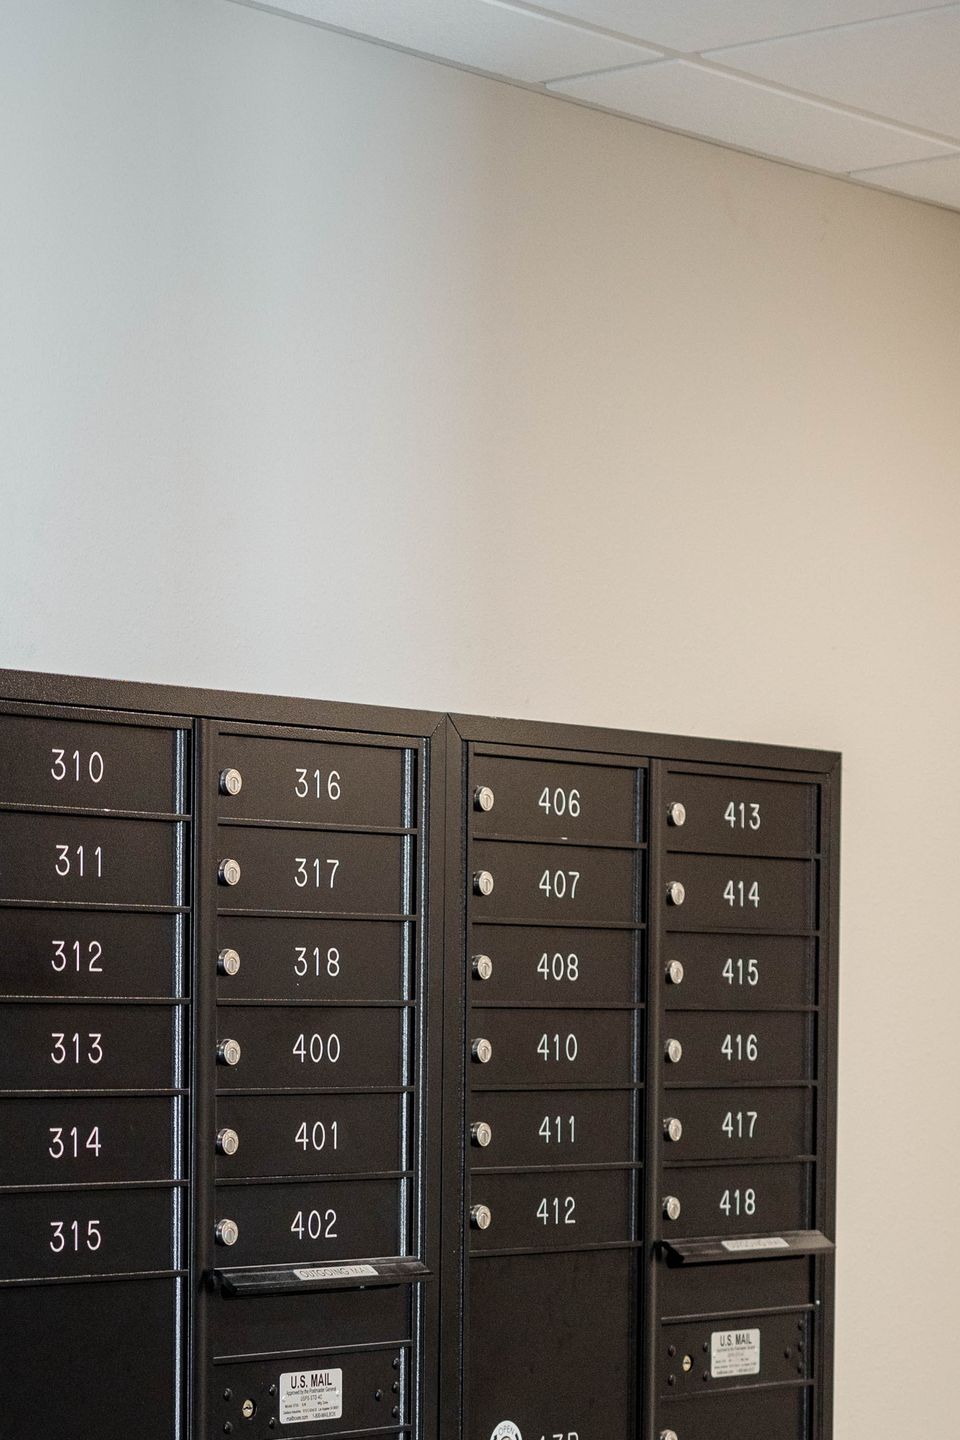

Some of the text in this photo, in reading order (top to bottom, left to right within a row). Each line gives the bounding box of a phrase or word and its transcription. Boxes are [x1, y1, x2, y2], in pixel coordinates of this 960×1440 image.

[50, 748, 104, 784] 310
[294, 767, 341, 801] 316
[537, 786, 581, 818] 406
[723, 801, 761, 831] 413
[54, 844, 102, 878] 311
[293, 857, 340, 889] 317
[538, 869, 580, 900] 407
[722, 879, 761, 909] 414
[51, 940, 103, 973] 312
[293, 946, 341, 977] 318
[536, 952, 579, 982] 408
[721, 957, 759, 986] 415
[50, 1032, 103, 1065] 313
[292, 1033, 341, 1064] 400
[536, 1033, 578, 1062] 410
[720, 1033, 758, 1062] 416
[294, 1120, 338, 1151] 401
[538, 1115, 575, 1144] 411
[721, 1110, 758, 1139] 417
[48, 1126, 102, 1159] 314
[536, 1196, 576, 1226] 412
[719, 1188, 756, 1217] 418
[49, 1219, 102, 1253] 315
[290, 1208, 338, 1240] 402
[299, 1267, 350, 1278] OUTGOING
[720, 1333, 752, 1347] U.S. MAIL
[290, 1373, 332, 1389] U.S. MAIL
[498, 1425, 516, 1436] OPEN
